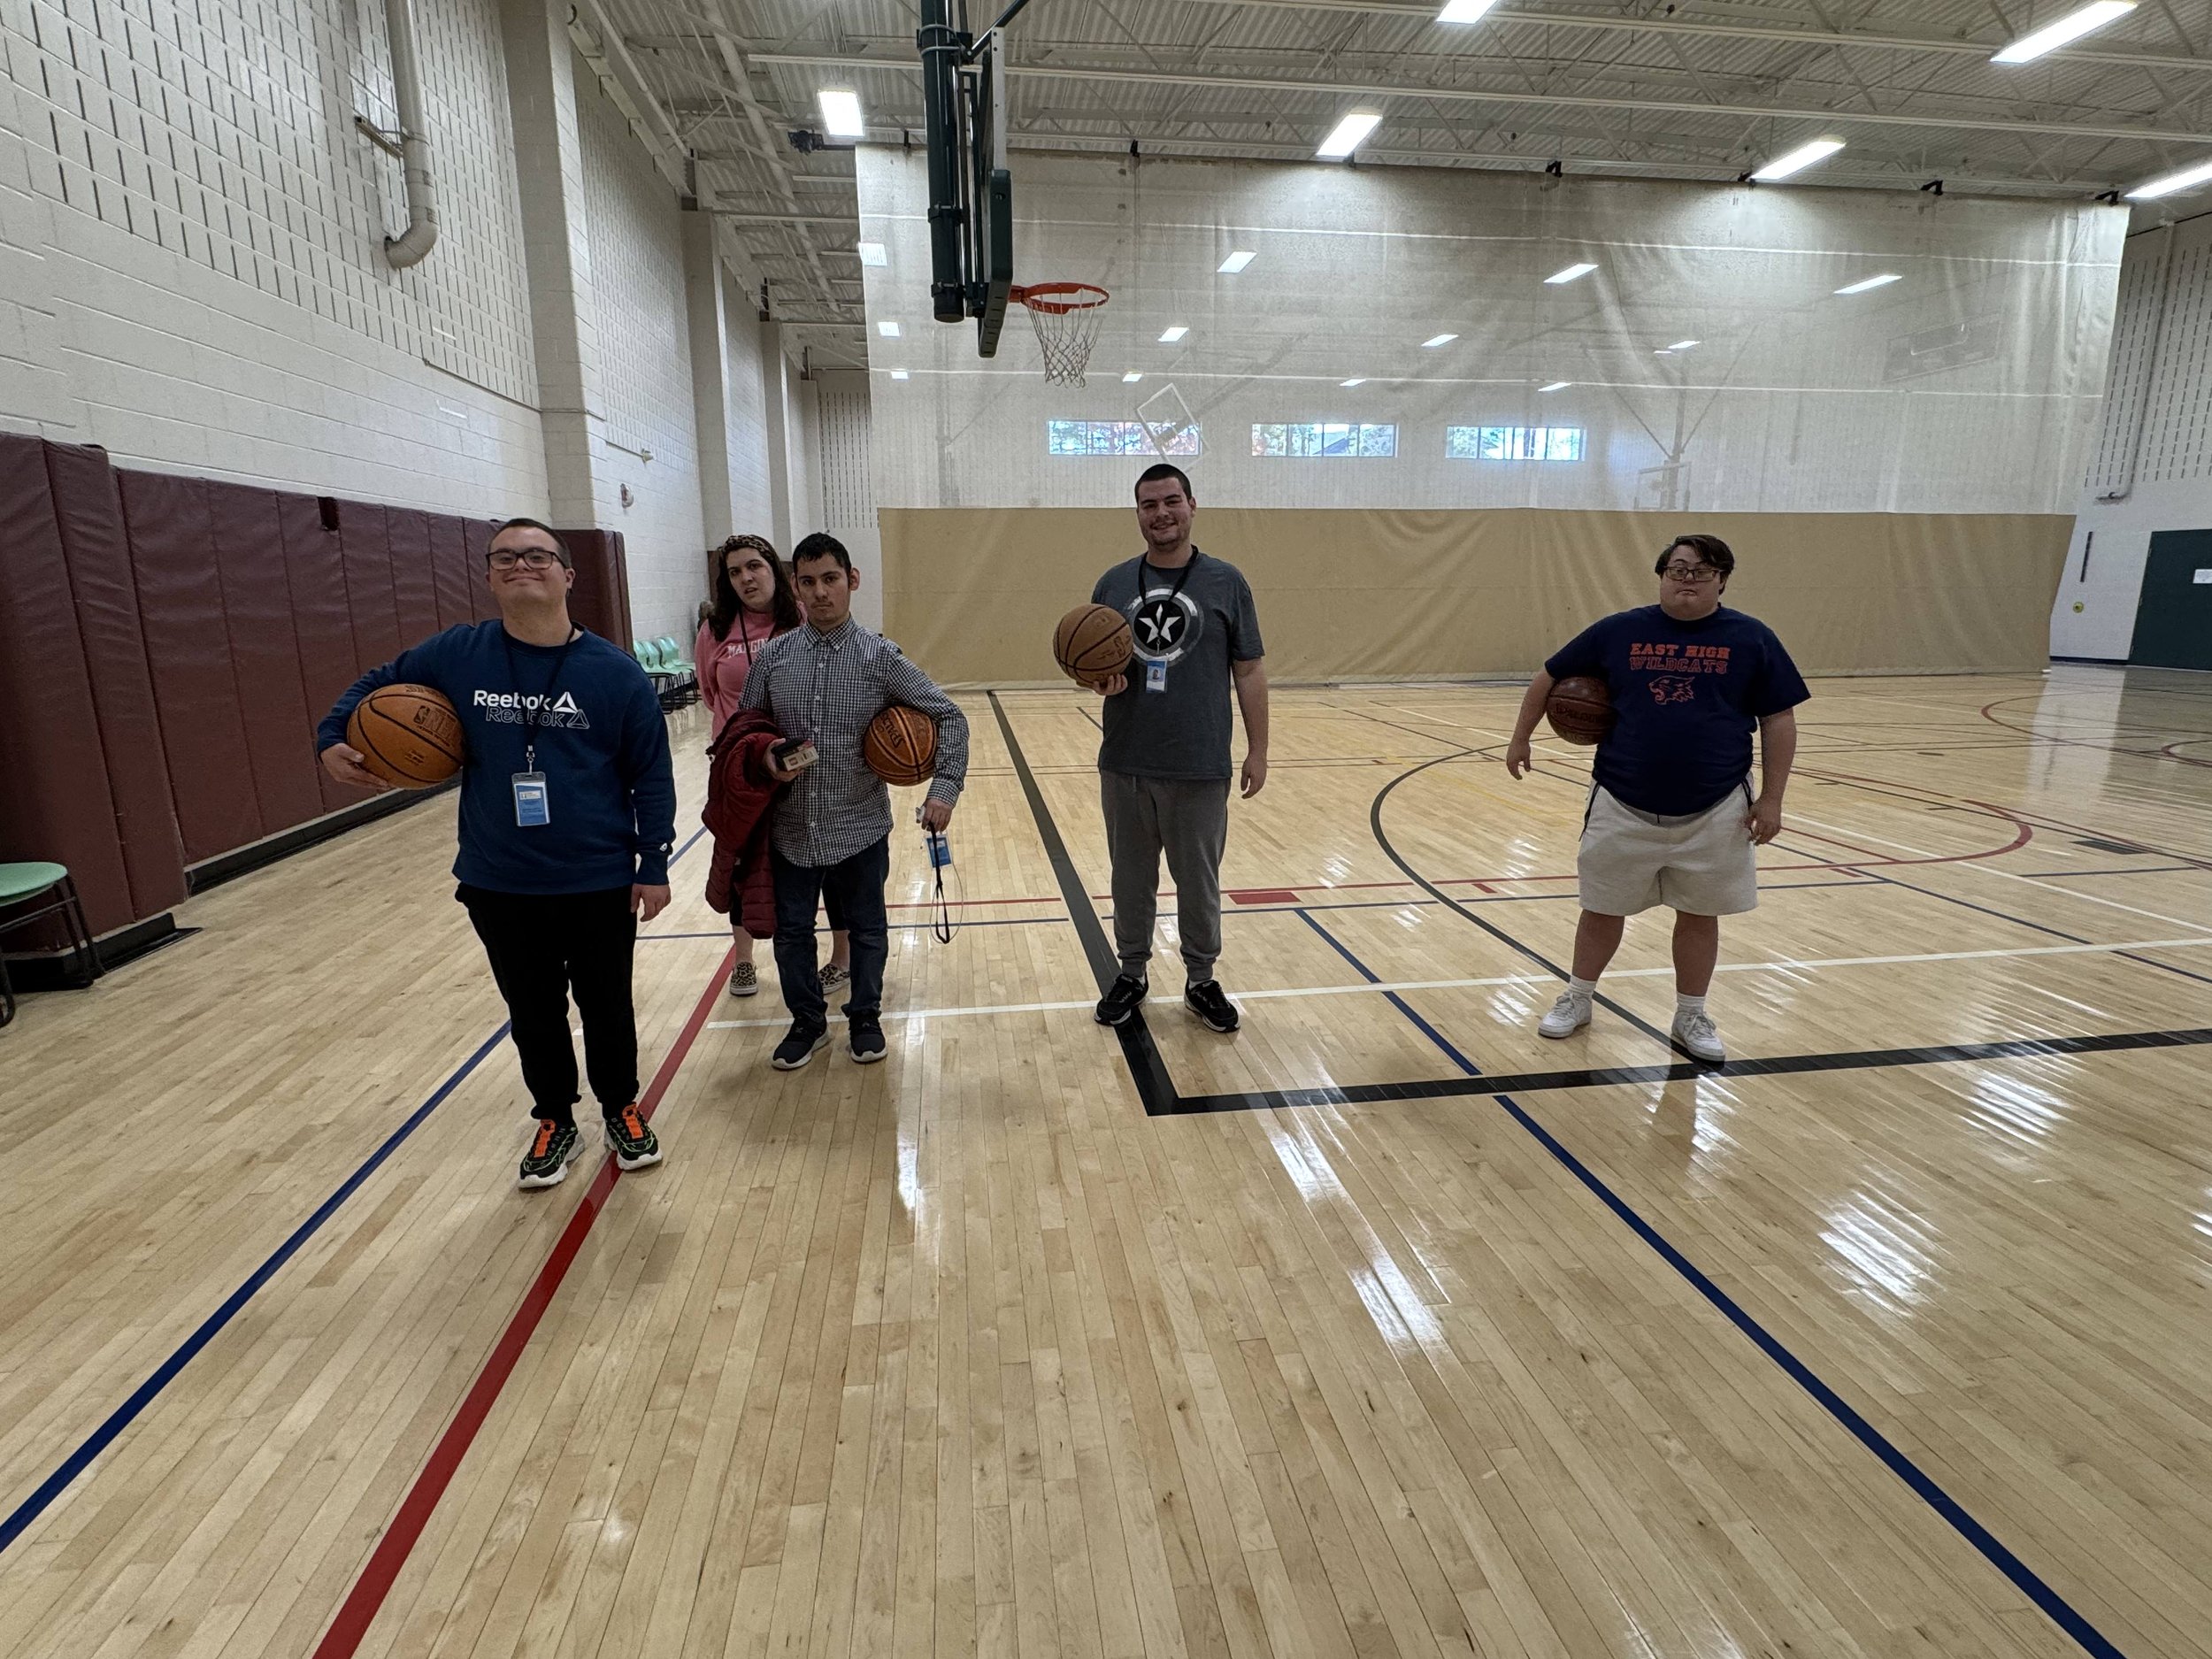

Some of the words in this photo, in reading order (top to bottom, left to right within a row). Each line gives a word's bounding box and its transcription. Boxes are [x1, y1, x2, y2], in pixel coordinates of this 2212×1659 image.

[1630, 643, 1679, 656] EAST
[1685, 645, 1731, 659] HIGH
[1629, 657, 1728, 674] WILDCATS
[473, 690, 552, 710] Reebok
